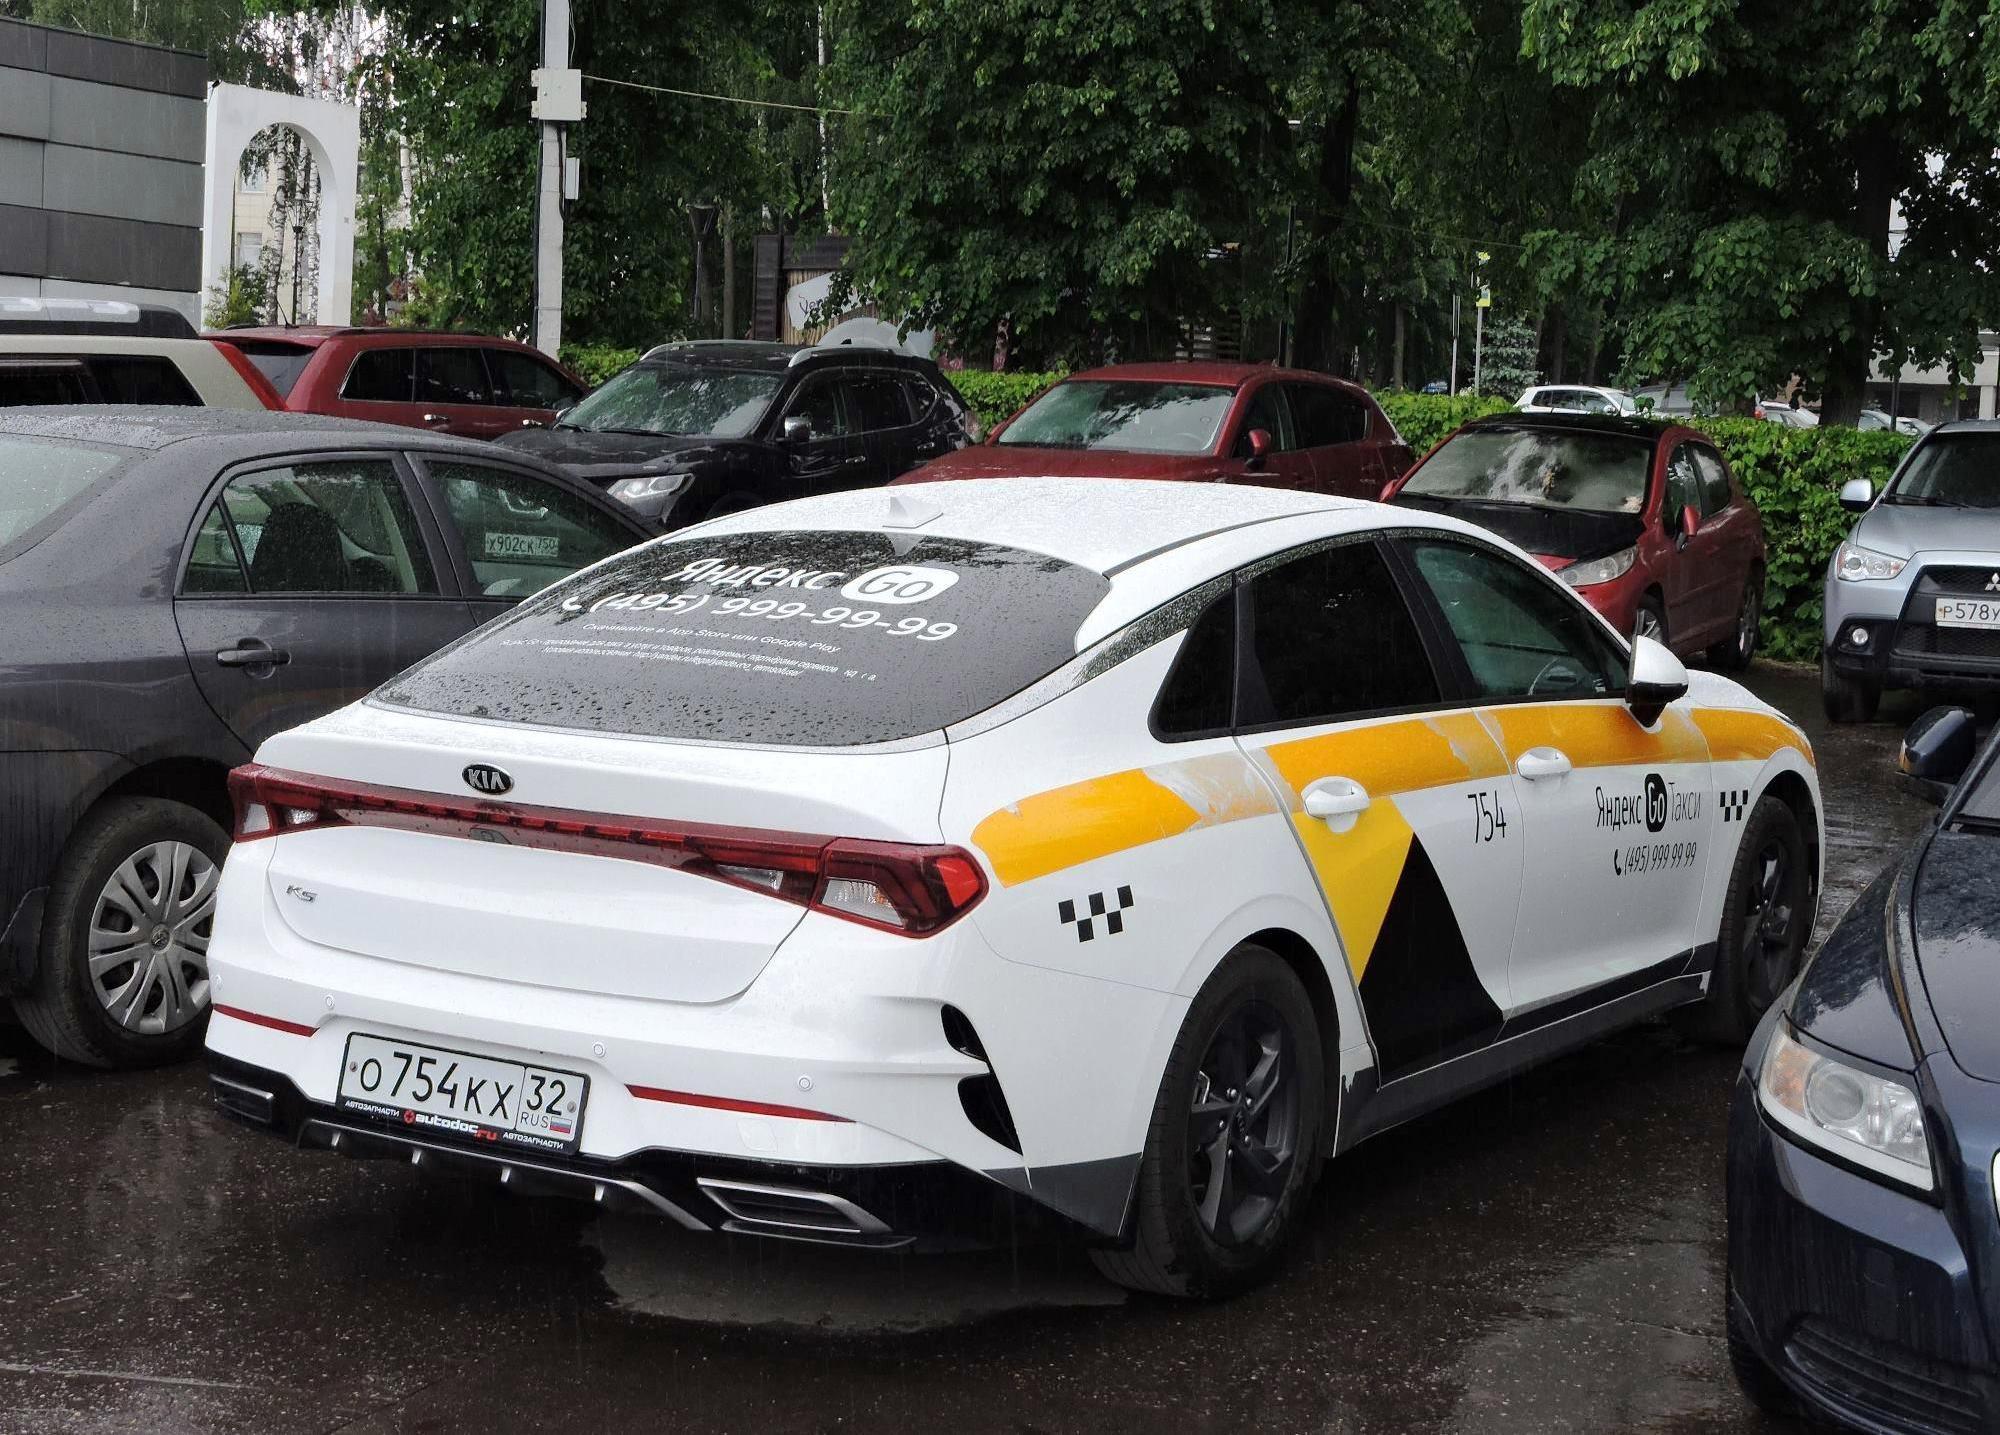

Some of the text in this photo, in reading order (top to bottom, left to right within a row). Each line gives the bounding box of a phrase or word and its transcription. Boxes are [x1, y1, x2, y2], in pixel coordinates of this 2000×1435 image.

[661, 557, 934, 598] Яндекс Go
[589, 592, 959, 641] (495) 999-99-99
[666, 627, 694, 636] App
[695, 629, 730, 638] Store
[731, 633, 759, 641] или
[760, 636, 808, 648] Google
[809, 642, 842, 654] Play
[467, 768, 506, 791] KIA
[1467, 790, 1507, 843] 754
[1595, 782, 1701, 831] Яндекс Go Такси
[1624, 841, 1697, 876] (495) 999 99 99
[286, 884, 318, 903] K5
[344, 1099, 400, 1118] АВТОЗАПЧАСТИ
[520, 1111, 549, 1129] RUS
[414, 1111, 498, 1141] autodoc.ru
[502, 1131, 564, 1150] АВТОЗАПЧАСТИ
